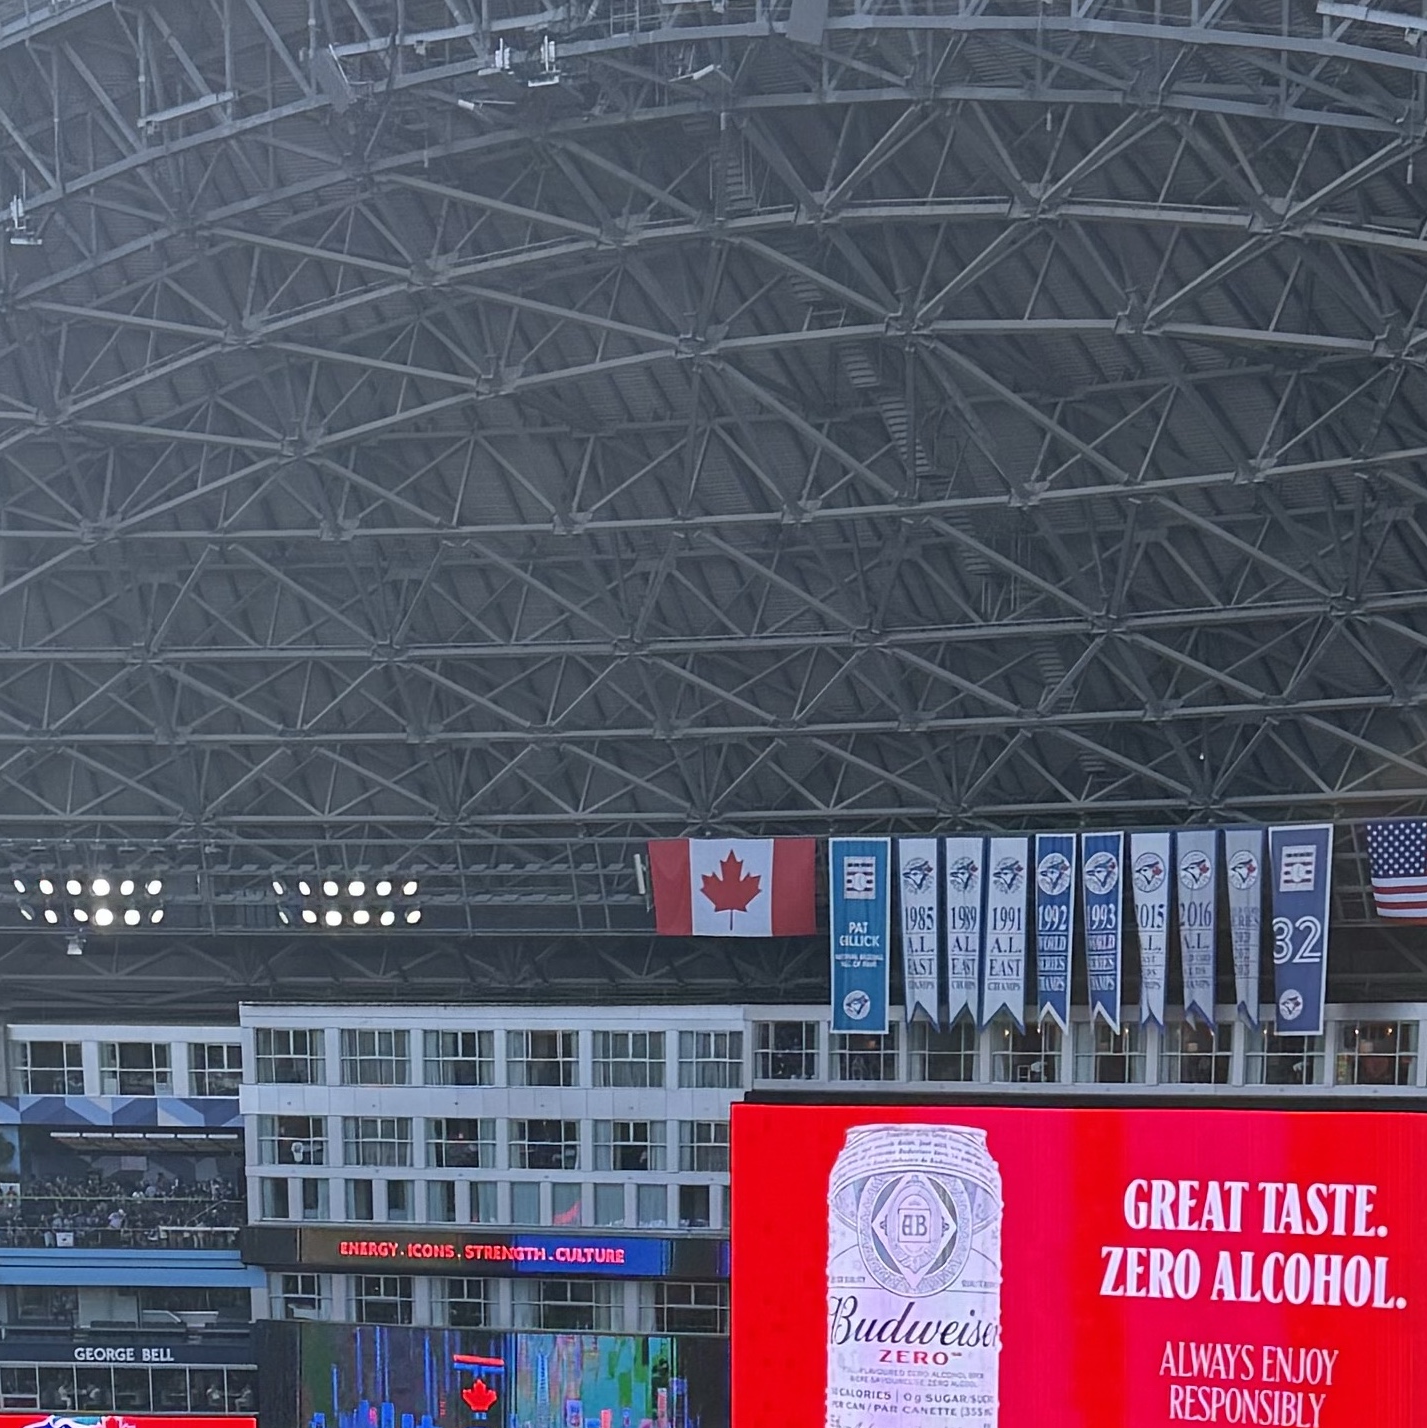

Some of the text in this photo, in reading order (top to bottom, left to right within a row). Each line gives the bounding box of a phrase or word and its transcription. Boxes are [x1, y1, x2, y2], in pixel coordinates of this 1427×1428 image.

[992, 906, 1021, 932] 1991
[1038, 905, 1067, 931] 1992
[1179, 901, 1212, 928] 2016
[848, 922, 869, 934] PAT
[1272, 916, 1322, 965] 32
[989, 958, 1021, 977] EAST
[1123, 1178, 1388, 1238] GREAT TASTE.
[340, 1241, 625, 1264] ENERGY ICONS STRENGTH CULTURE
[1099, 1246, 1407, 1310] ZERO ALCOHOL.
[74, 1346, 174, 1362] GEORGE BELL
[1159, 1340, 1339, 1386] ALWAYS ENJOY
[839, 1389, 892, 1401] CALORIES
[902, 1405, 957, 1417] CANETTE
